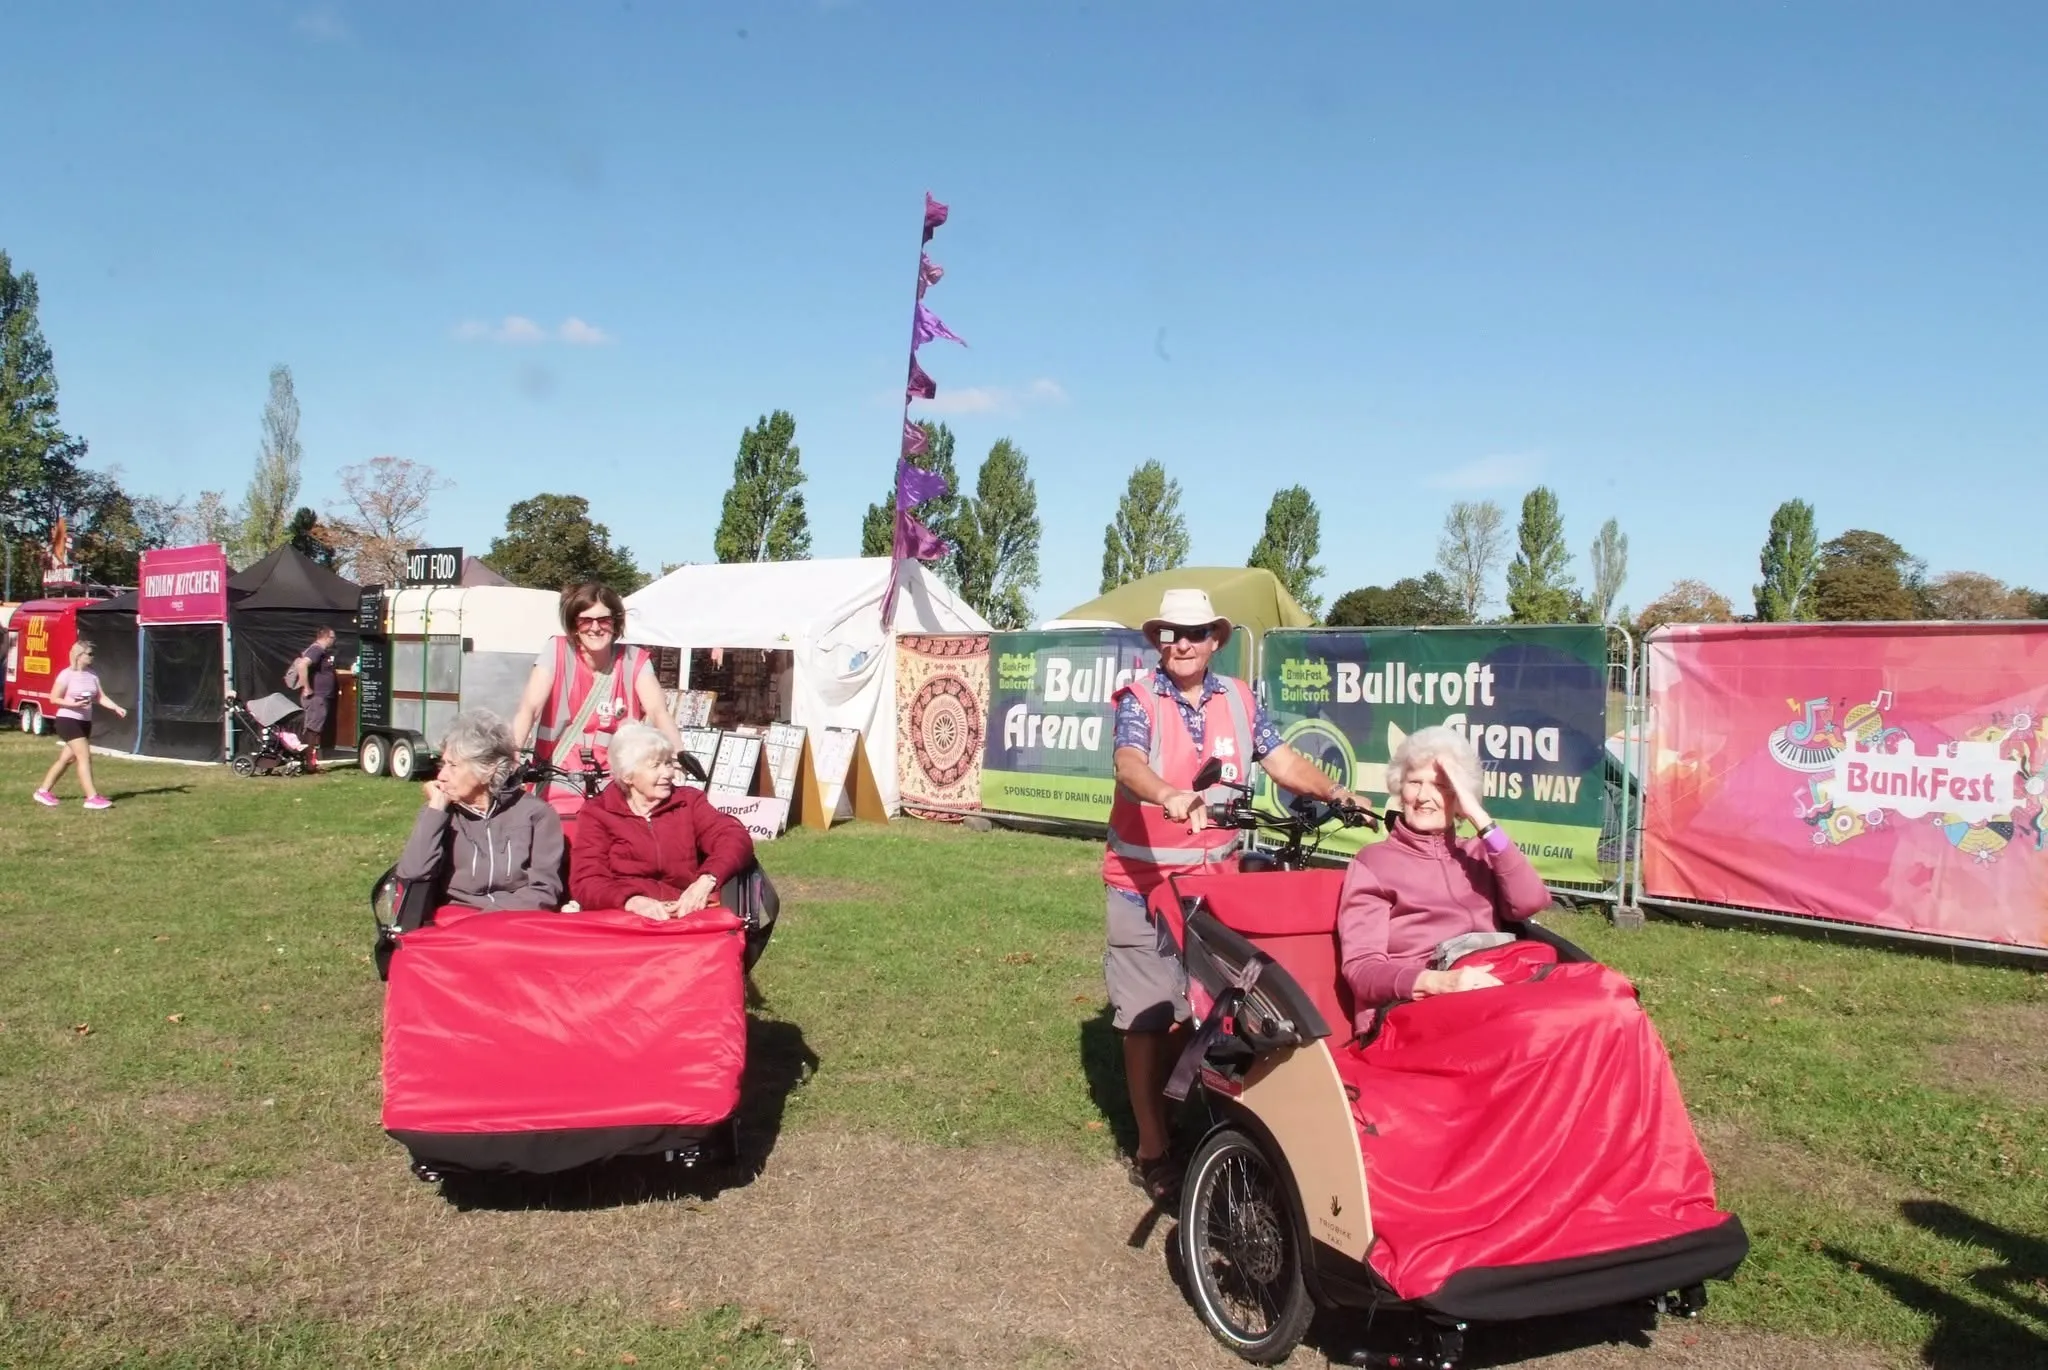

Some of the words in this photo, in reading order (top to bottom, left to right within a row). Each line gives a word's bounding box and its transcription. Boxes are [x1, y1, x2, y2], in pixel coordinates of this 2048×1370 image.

[406, 554, 428, 580] HOT
[430, 553, 456, 579] FOOD
[145, 574, 175, 597] INDIAN
[175, 570, 220, 595] KITCHEN
[1281, 687, 1330, 702] Bullcroft
[1337, 662, 1495, 706] Bullcroft
[1004, 703, 1103, 751] Arena
[1004, 785, 1051, 799] SPONSORED
[1053, 790, 1064, 800] BY
[1065, 791, 1090, 803] DRAIN
[1092, 793, 1112, 805] GAIN
[1483, 771, 1522, 799] HIS
[1532, 774, 1582, 804] WAY
[1847, 762, 1995, 803] BunkFest
[717, 801, 762, 815] mporary
[1543, 845, 1574, 860] GAIN
